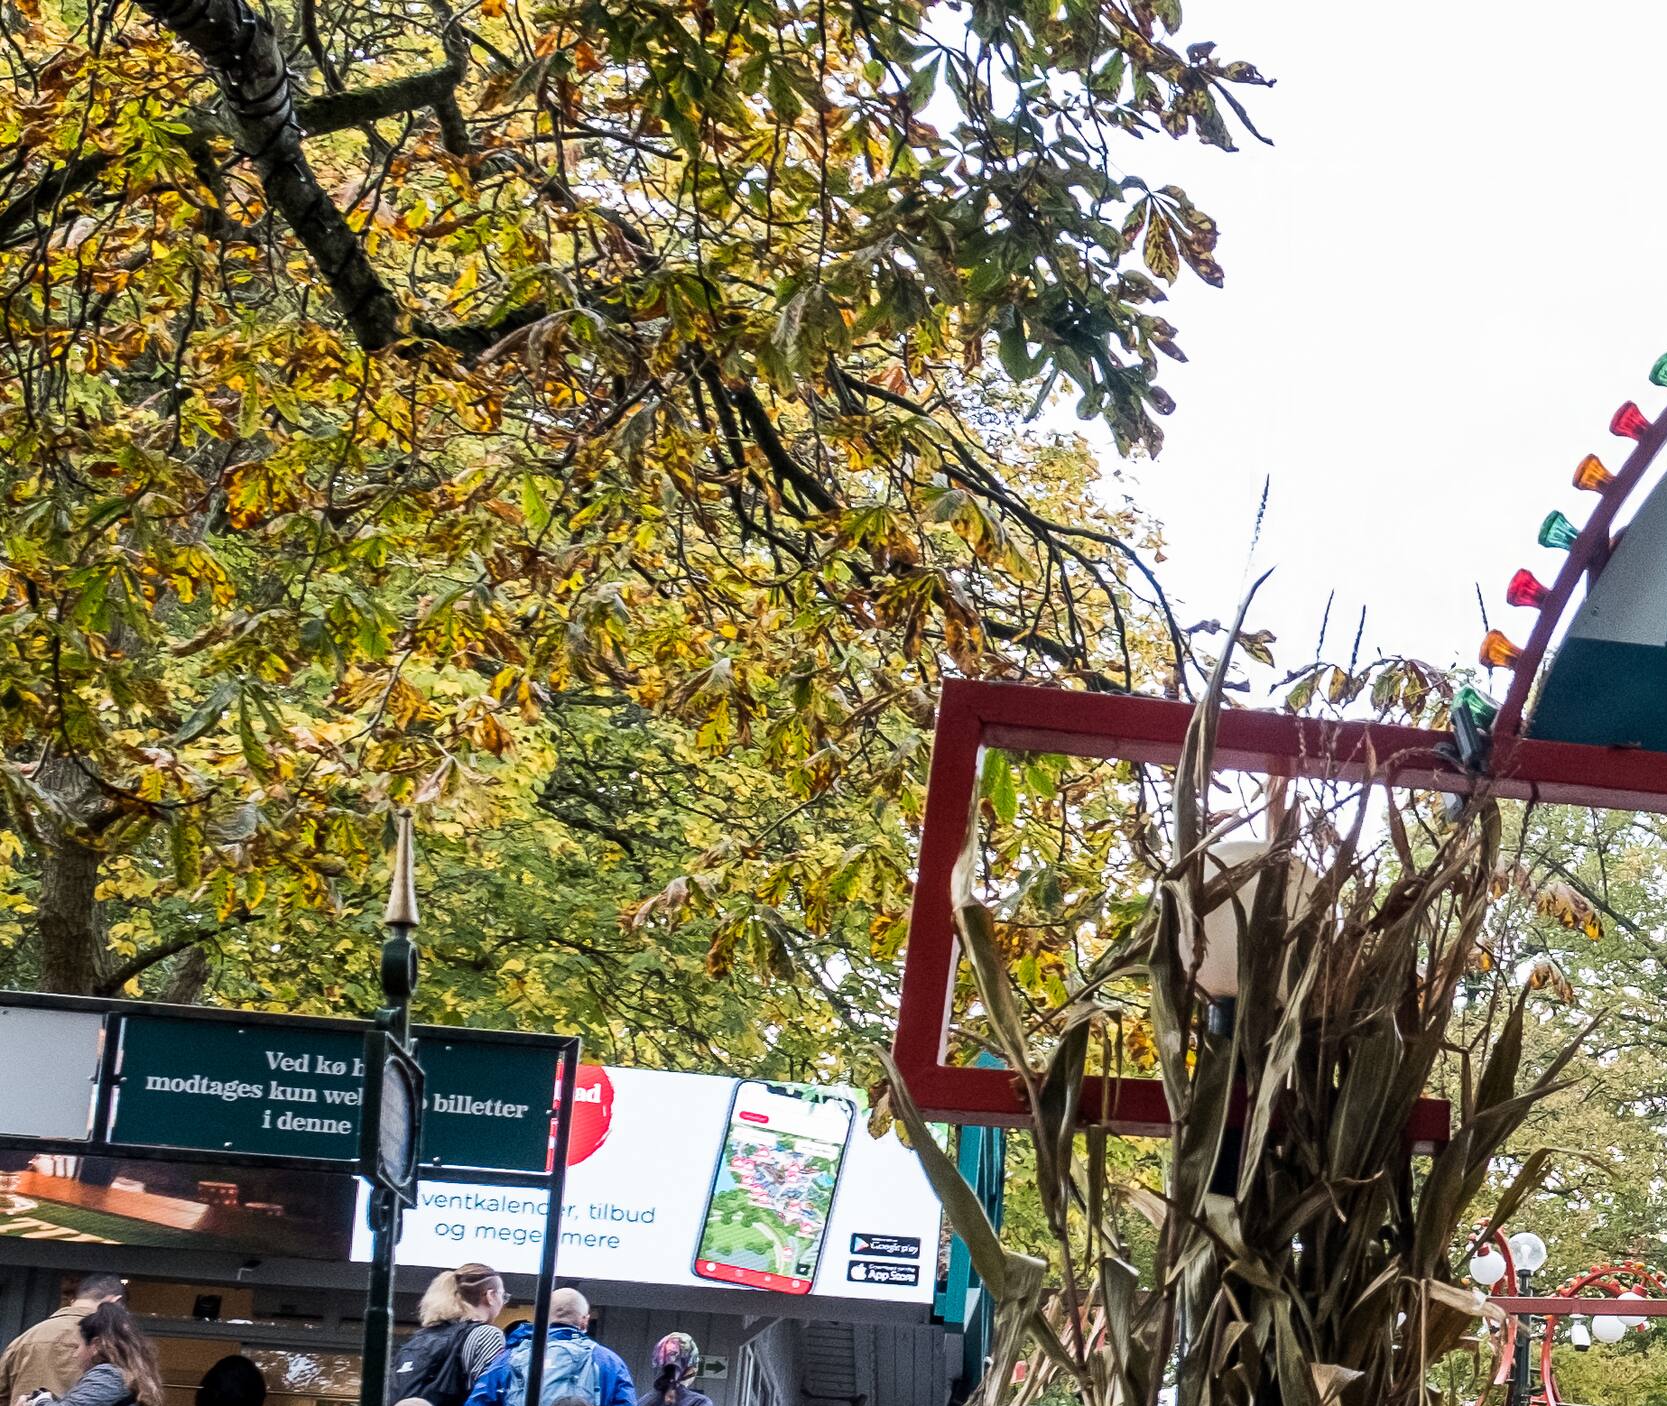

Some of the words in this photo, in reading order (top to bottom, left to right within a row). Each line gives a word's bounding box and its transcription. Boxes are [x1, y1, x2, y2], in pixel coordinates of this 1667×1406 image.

[266, 1051, 309, 1073] Ved
[315, 1055, 346, 1076] kø
[145, 1075, 263, 1101] modtages
[268, 1081, 317, 1102] kun
[434, 1093, 529, 1119] billetter
[262, 1109, 272, 1129] i
[276, 1111, 351, 1134] denne
[590, 1203, 656, 1224] tilbud
[434, 1223, 465, 1241] og
[475, 1225, 543, 1245] mege
[561, 1232, 620, 1249] mere
[868, 1269, 890, 1282] App
